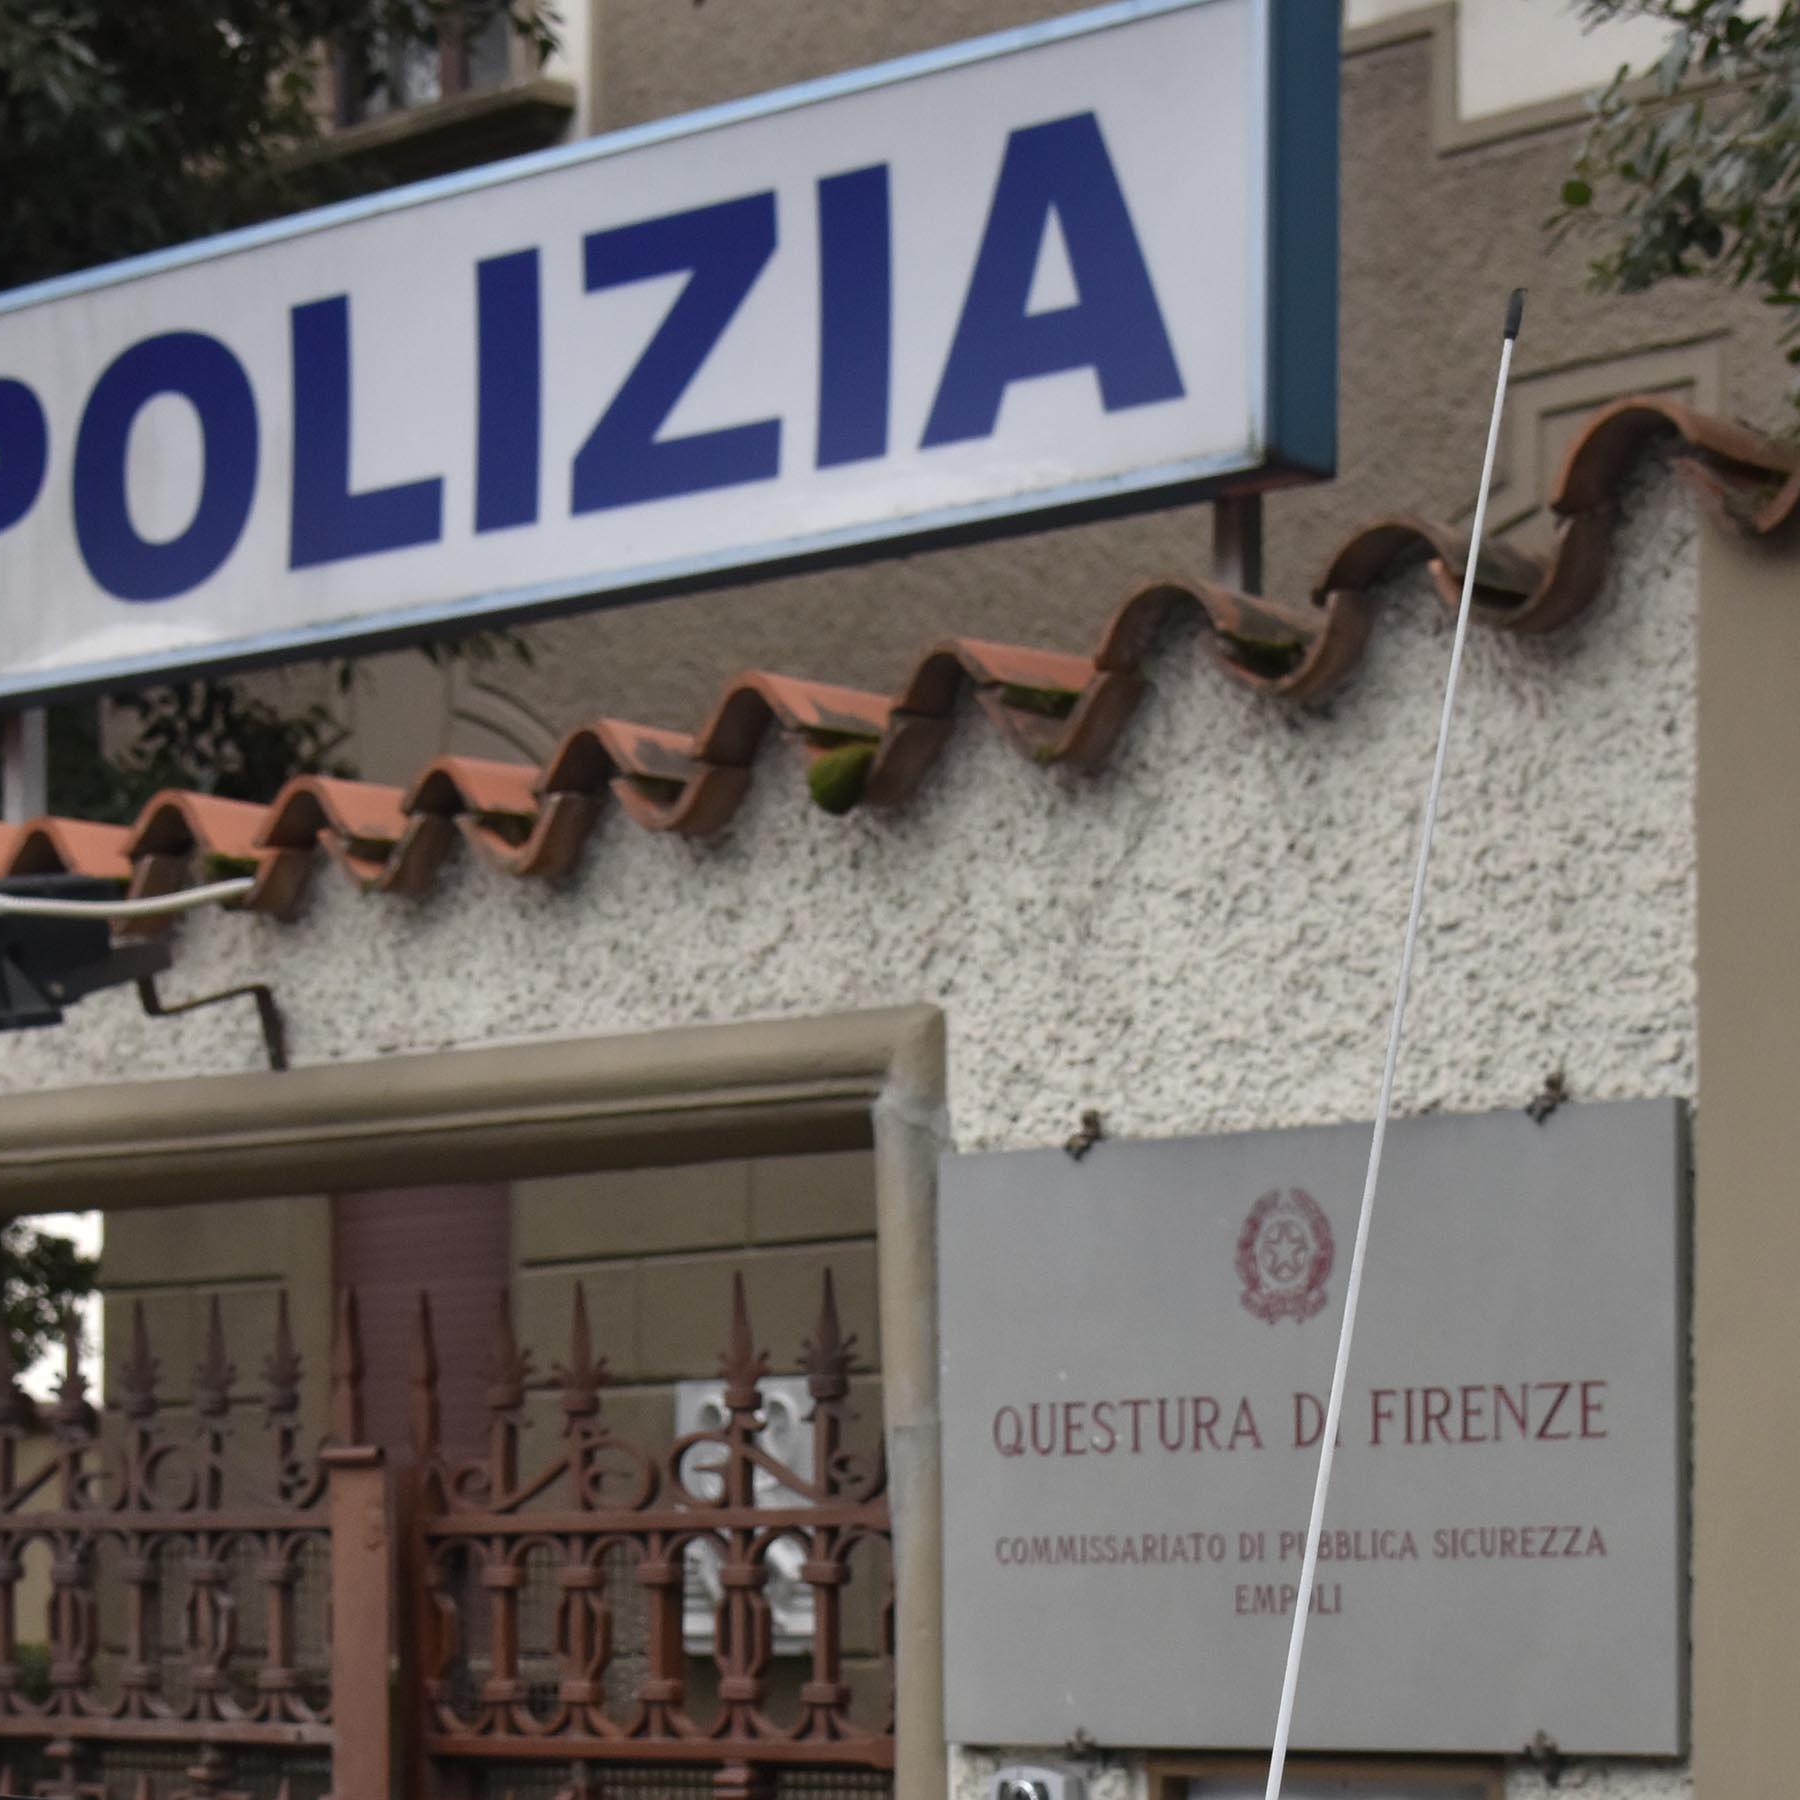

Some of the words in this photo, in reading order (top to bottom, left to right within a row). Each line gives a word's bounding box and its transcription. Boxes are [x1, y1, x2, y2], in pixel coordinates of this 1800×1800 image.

[992, 1396, 1263, 1457] QUESTURA
[1294, 1391, 1342, 1449] D
[1370, 1379, 1608, 1445] FIRENZE
[996, 1532, 1226, 1566] COMMISSARIATO
[1238, 1531, 1265, 1562] DI
[1432, 1524, 1608, 1560] SICUREZZA
[1233, 1582, 1343, 1616] EMPLI
